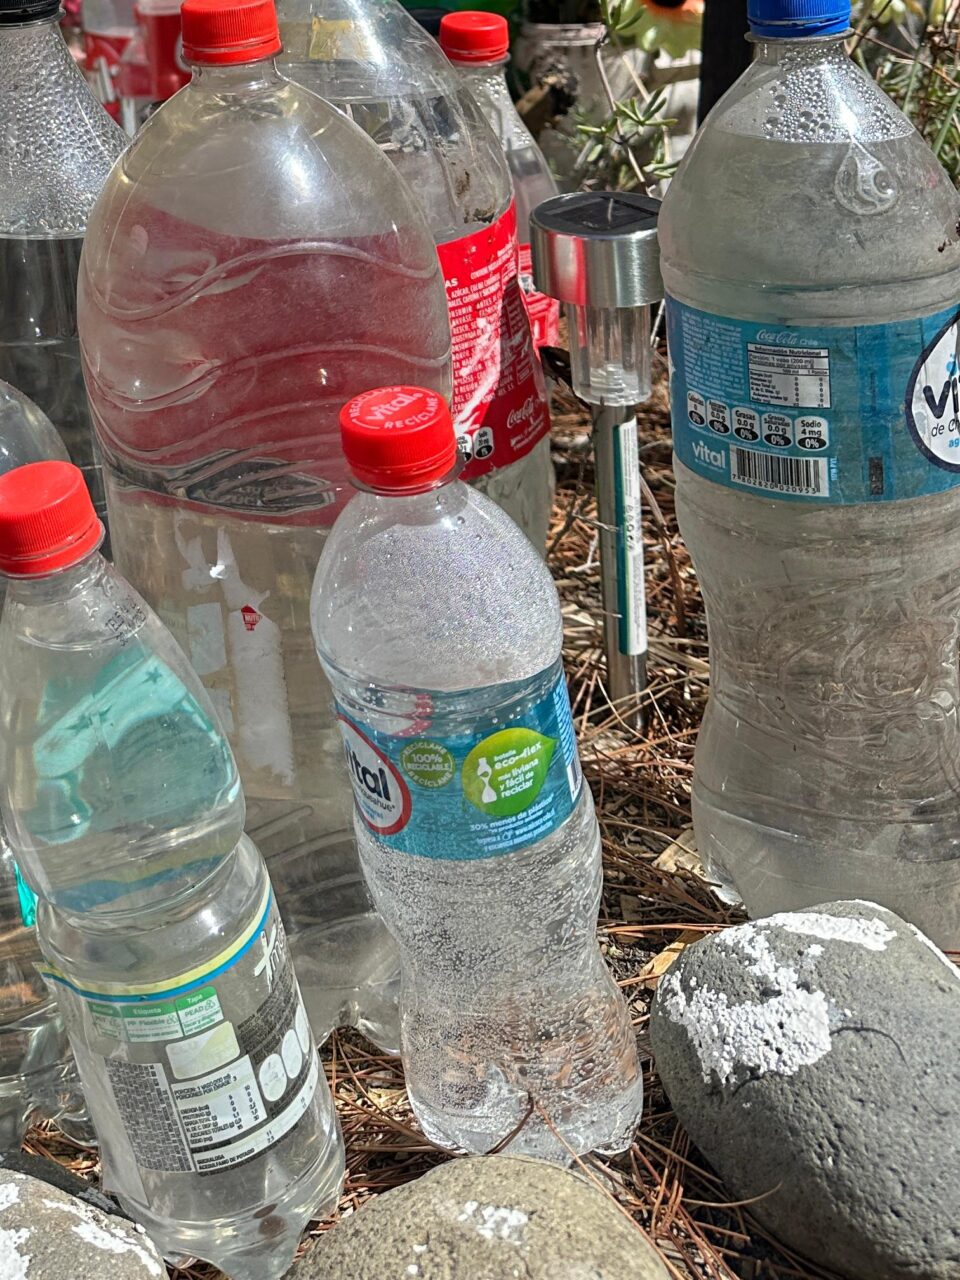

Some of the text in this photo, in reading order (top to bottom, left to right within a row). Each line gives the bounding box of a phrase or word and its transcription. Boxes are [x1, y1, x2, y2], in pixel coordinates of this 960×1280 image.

[365, 393, 418, 420] vital
[384, 397, 439, 429] RECICLAME
[767, 425, 780, 433] 0.0
[801, 420, 822, 428] Sodio
[740, 429, 753, 440] 0%
[801, 428, 822, 438] 4 mg
[770, 436, 785, 446] 0%
[805, 439, 820, 449] 0%
[691, 441, 726, 469] vital
[410, 753, 442, 763] 100%
[512, 758, 538, 776] liviana
[506, 774, 525, 788] fácil
[525, 771, 534, 779] de
[501, 779, 533, 797] reciclar
